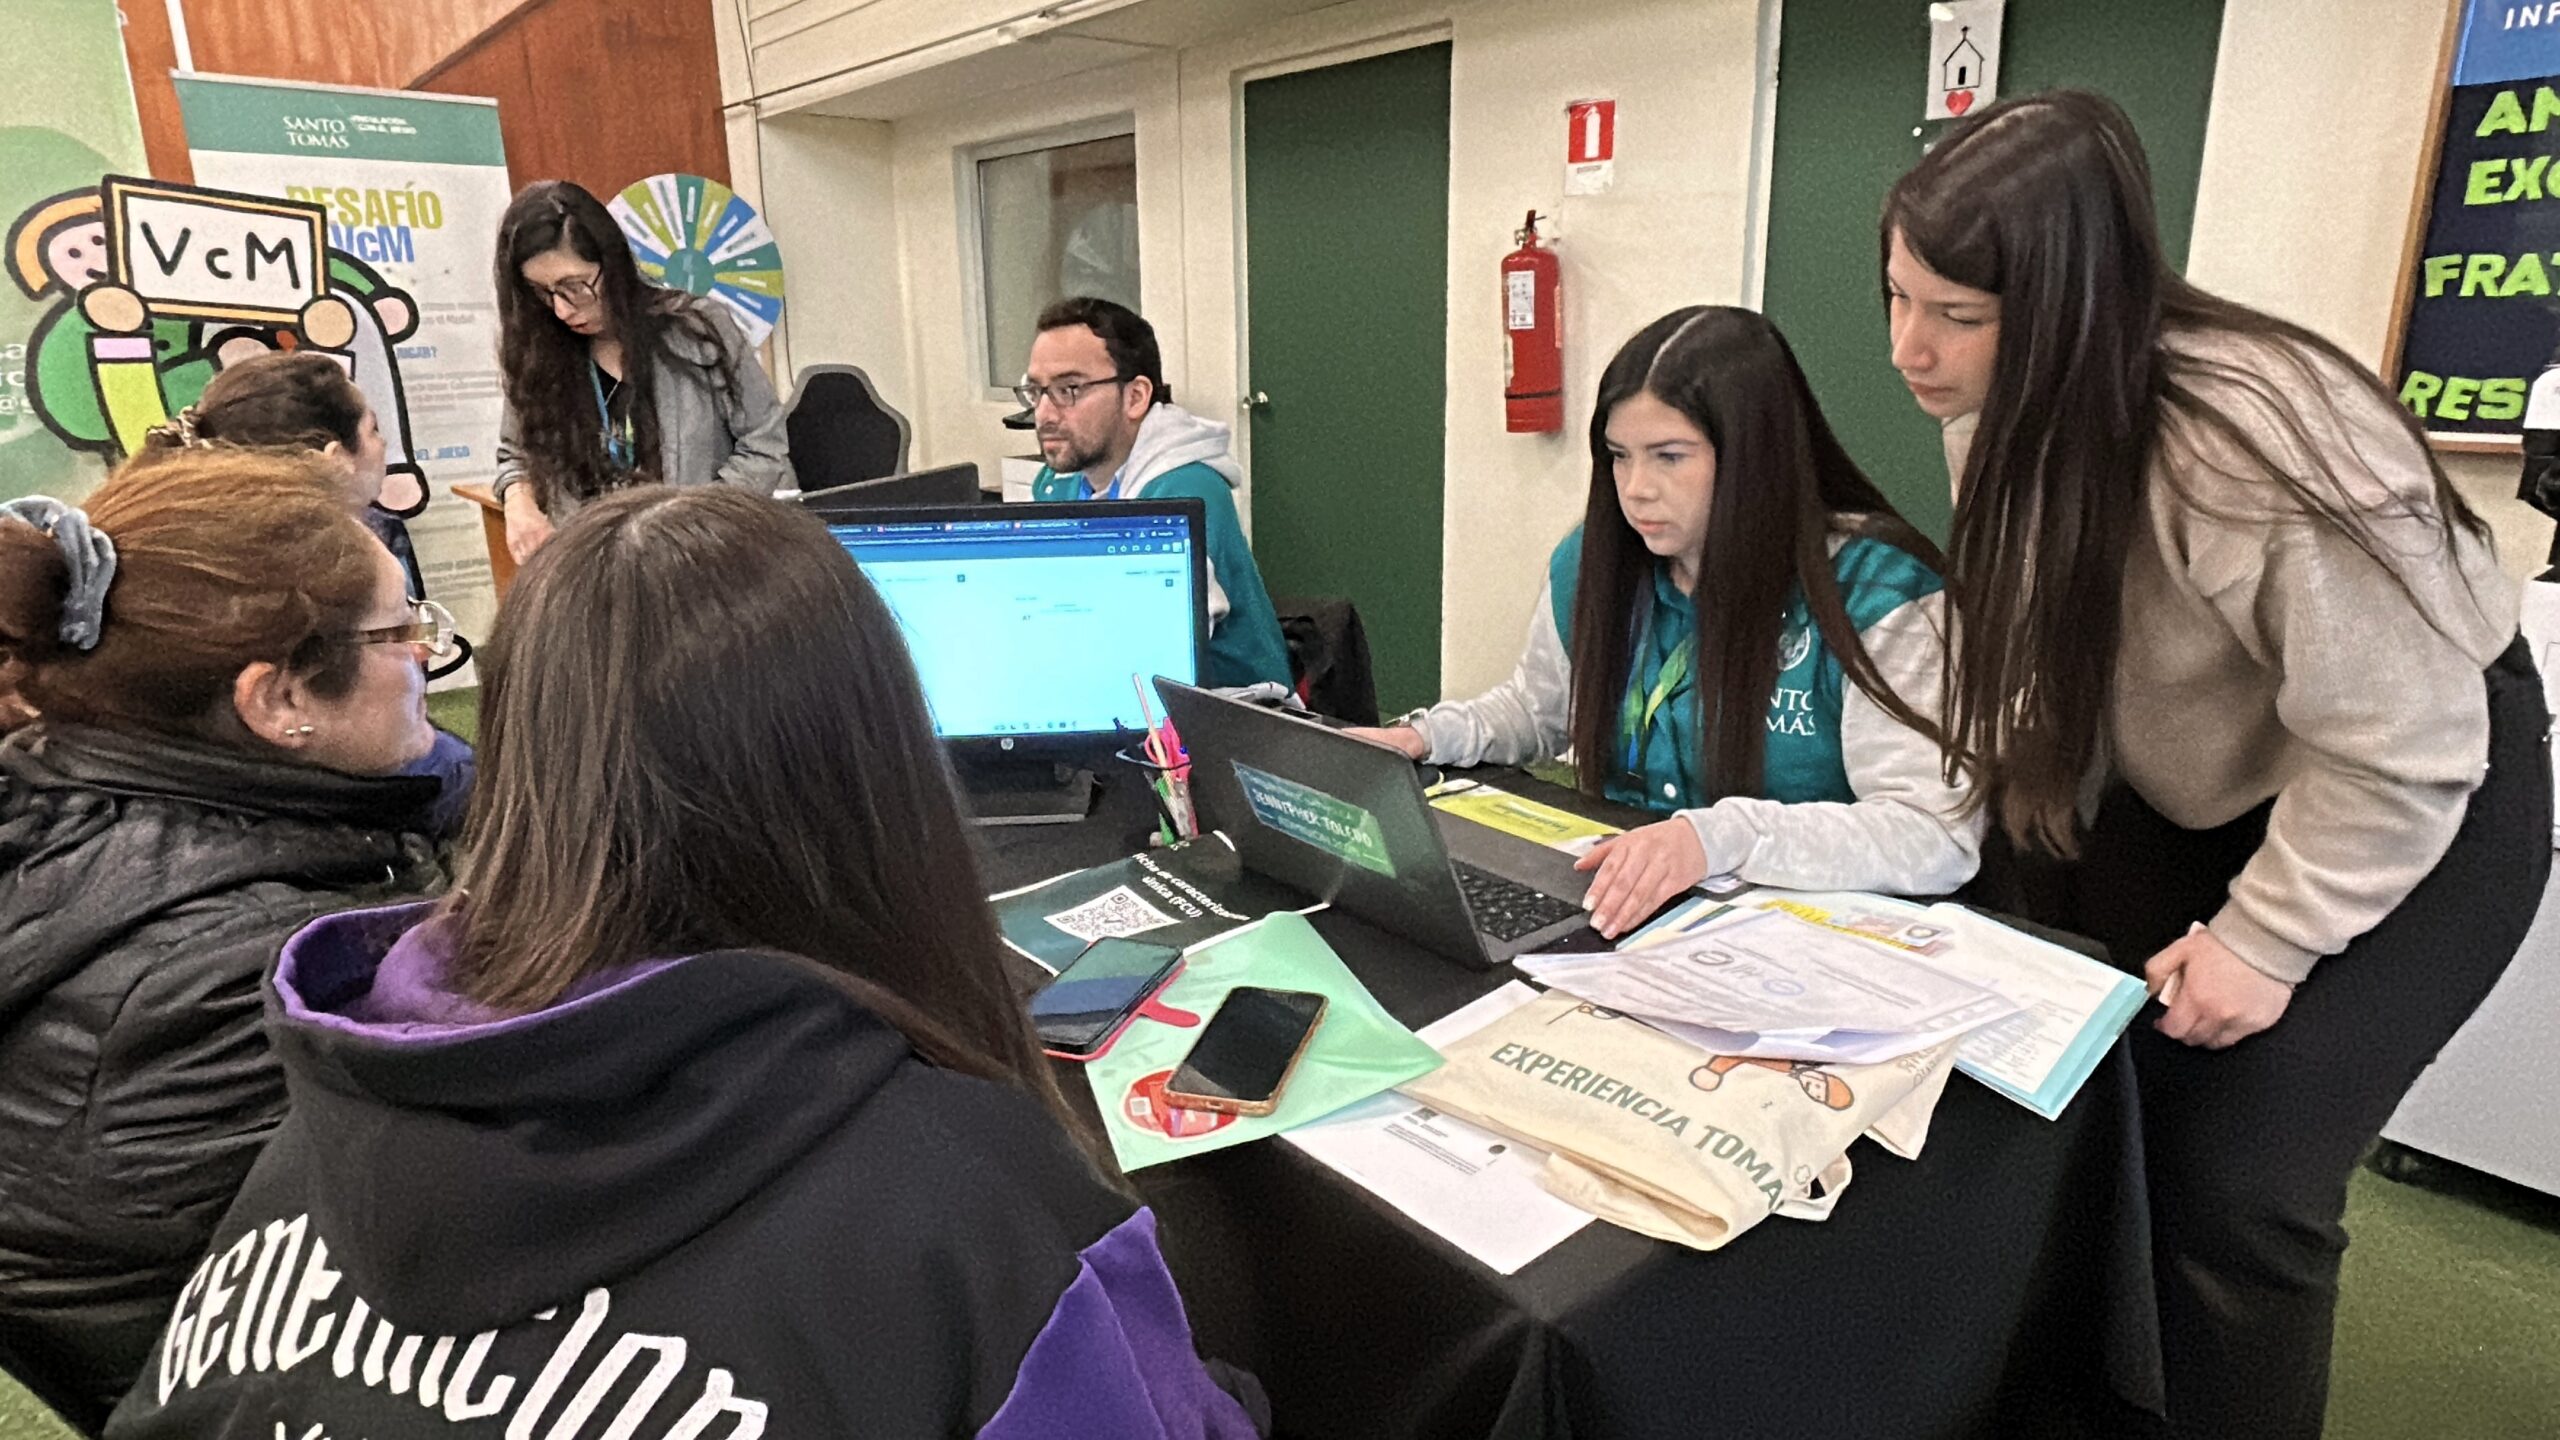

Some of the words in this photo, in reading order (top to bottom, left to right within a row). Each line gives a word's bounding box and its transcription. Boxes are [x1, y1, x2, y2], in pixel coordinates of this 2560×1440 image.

[282, 115, 346, 134] SANTO
[140, 221, 300, 289] VcM
[330, 222, 415, 263] VcM
[1770, 687, 1814, 711] NTO
[1765, 711, 1816, 736] MÁS
[1490, 1042, 1690, 1137] EXPERIENCIA
[1694, 1124, 1784, 1211] TOMA
